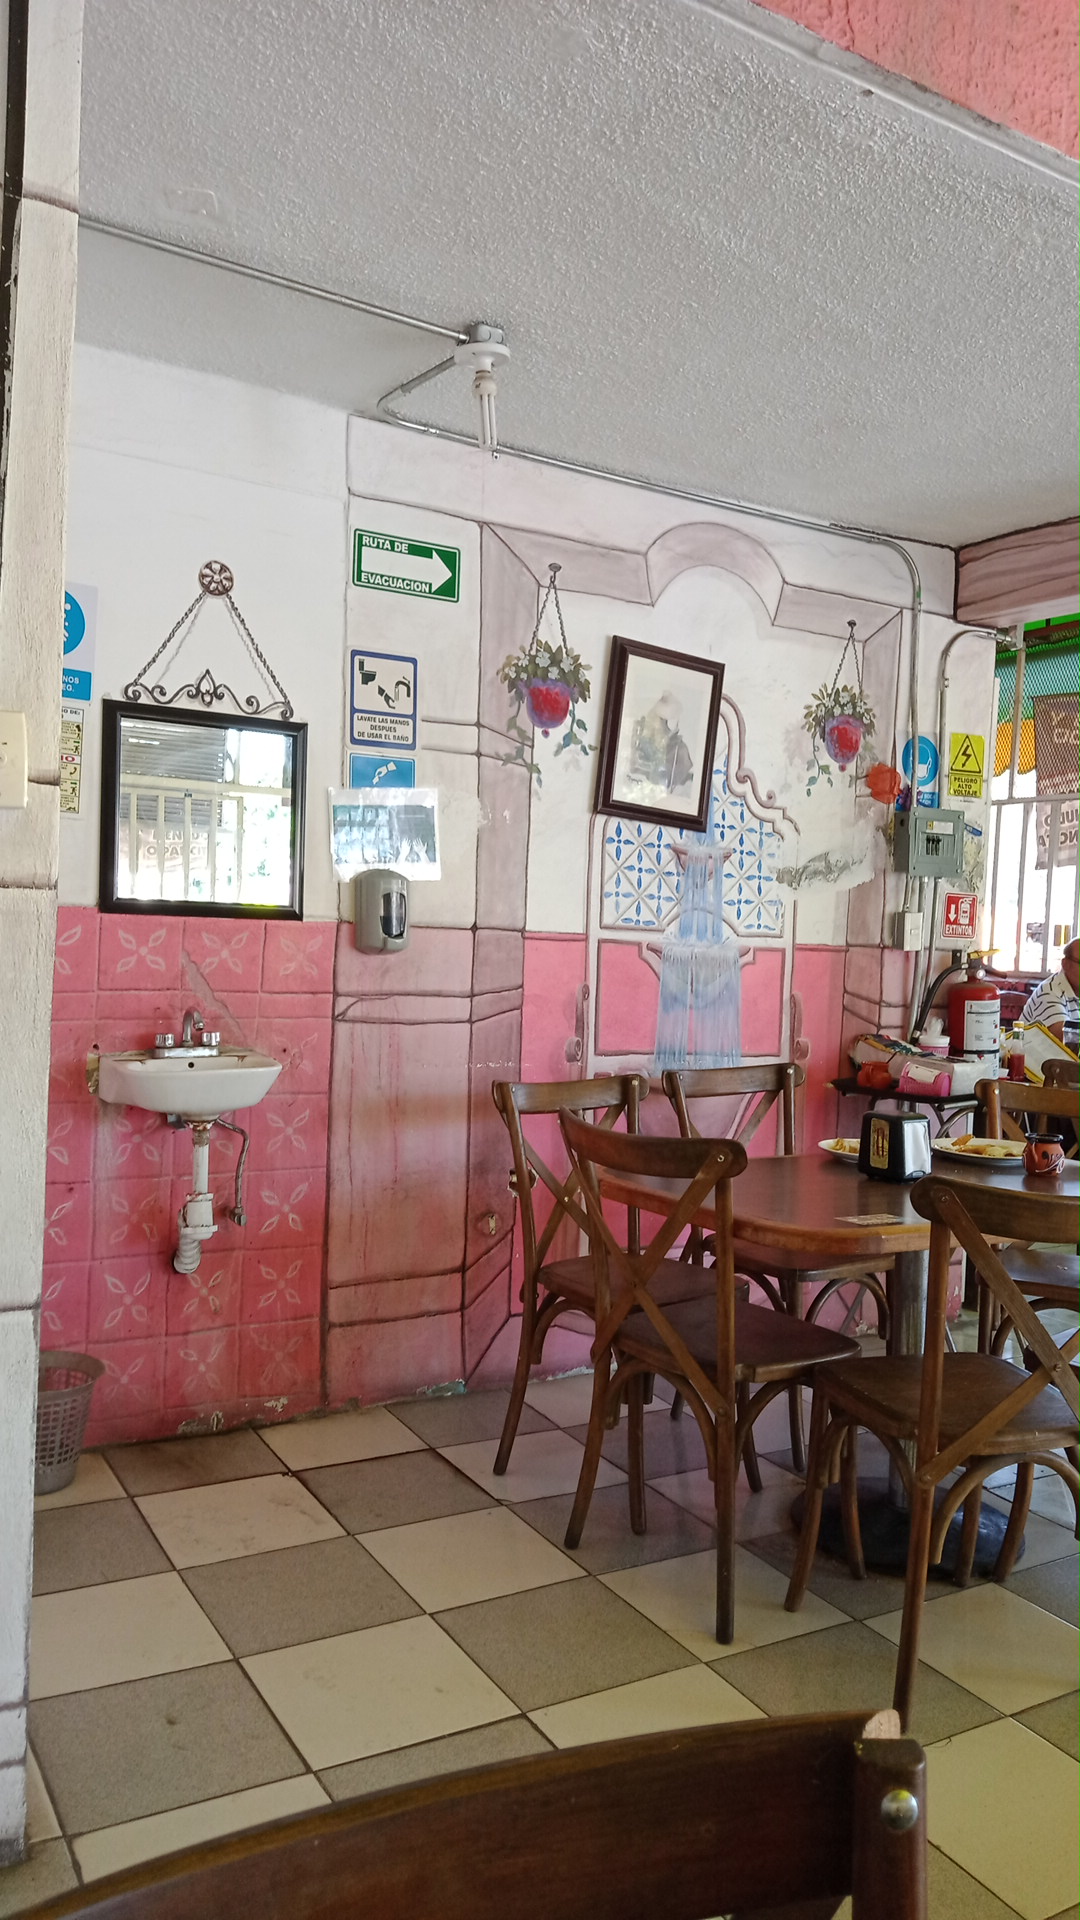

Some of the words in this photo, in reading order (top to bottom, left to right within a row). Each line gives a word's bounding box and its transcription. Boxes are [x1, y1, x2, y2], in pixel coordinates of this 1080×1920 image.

[362, 535, 391, 550] RUTA
[394, 542, 408, 553] DE
[361, 572, 430, 593] EVACUACION
[356, 715, 377, 723] LAVATE
[389, 718, 410, 726] MANOS
[370, 724, 397, 733] DESPUES
[953, 776, 978, 784] PELIGRO
[953, 788, 977, 796] VOLTAJE
[945, 924, 973, 936] EXTINTOR
